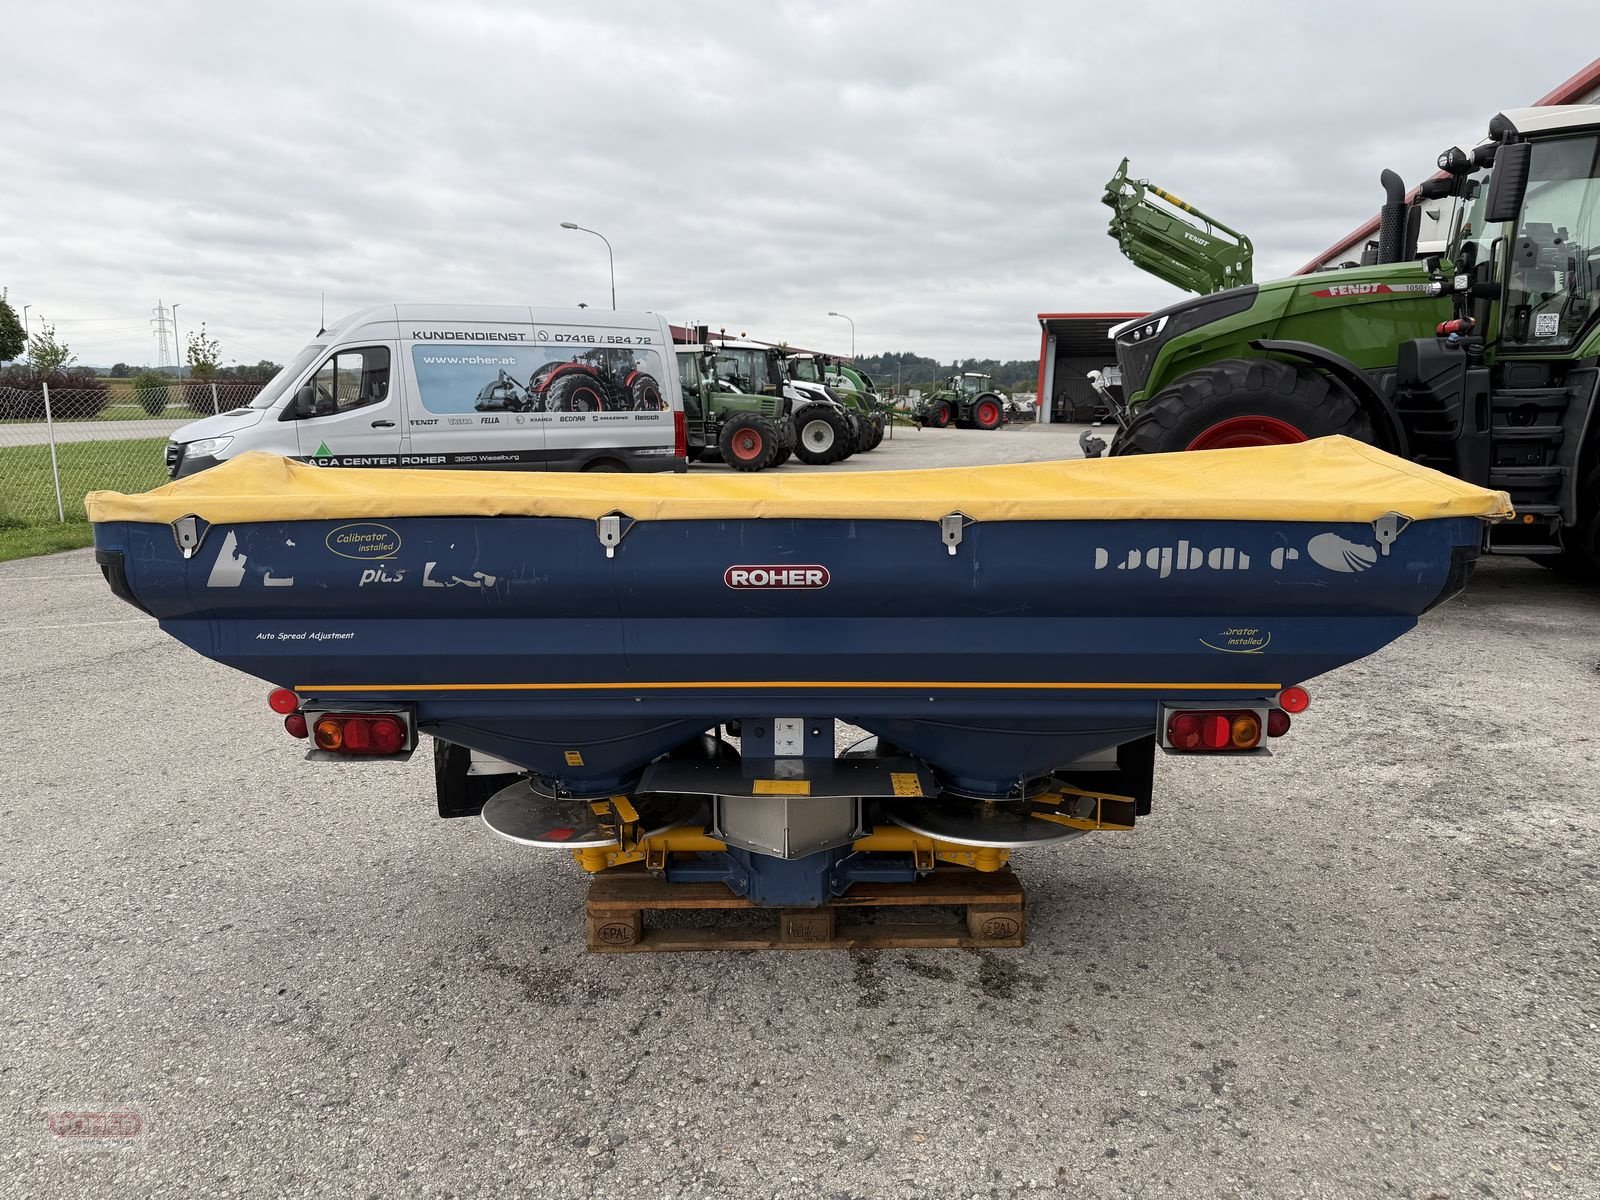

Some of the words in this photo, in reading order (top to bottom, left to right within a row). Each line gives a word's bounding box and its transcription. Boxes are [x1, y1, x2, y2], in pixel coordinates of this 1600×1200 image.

[1328, 282, 1381, 296] FENDT
[412, 331, 526, 341] KUNDENDIENST
[554, 334, 595, 343] 07416
[607, 336, 632, 344] 524
[635, 337, 652, 345] 72
[423, 355, 516, 364] www.roher.at
[343, 457, 397, 466] CENTER
[401, 456, 447, 465] ROHER
[336, 533, 387, 543] Calibrator
[358, 542, 394, 552] installed
[731, 570, 823, 586] ROHER
[255, 632, 275, 640] Auto
[277, 632, 307, 641] Spread
[308, 632, 355, 641] Adjustment
[1228, 637, 1264, 645] installed
[603, 927, 631, 940] EPAL
